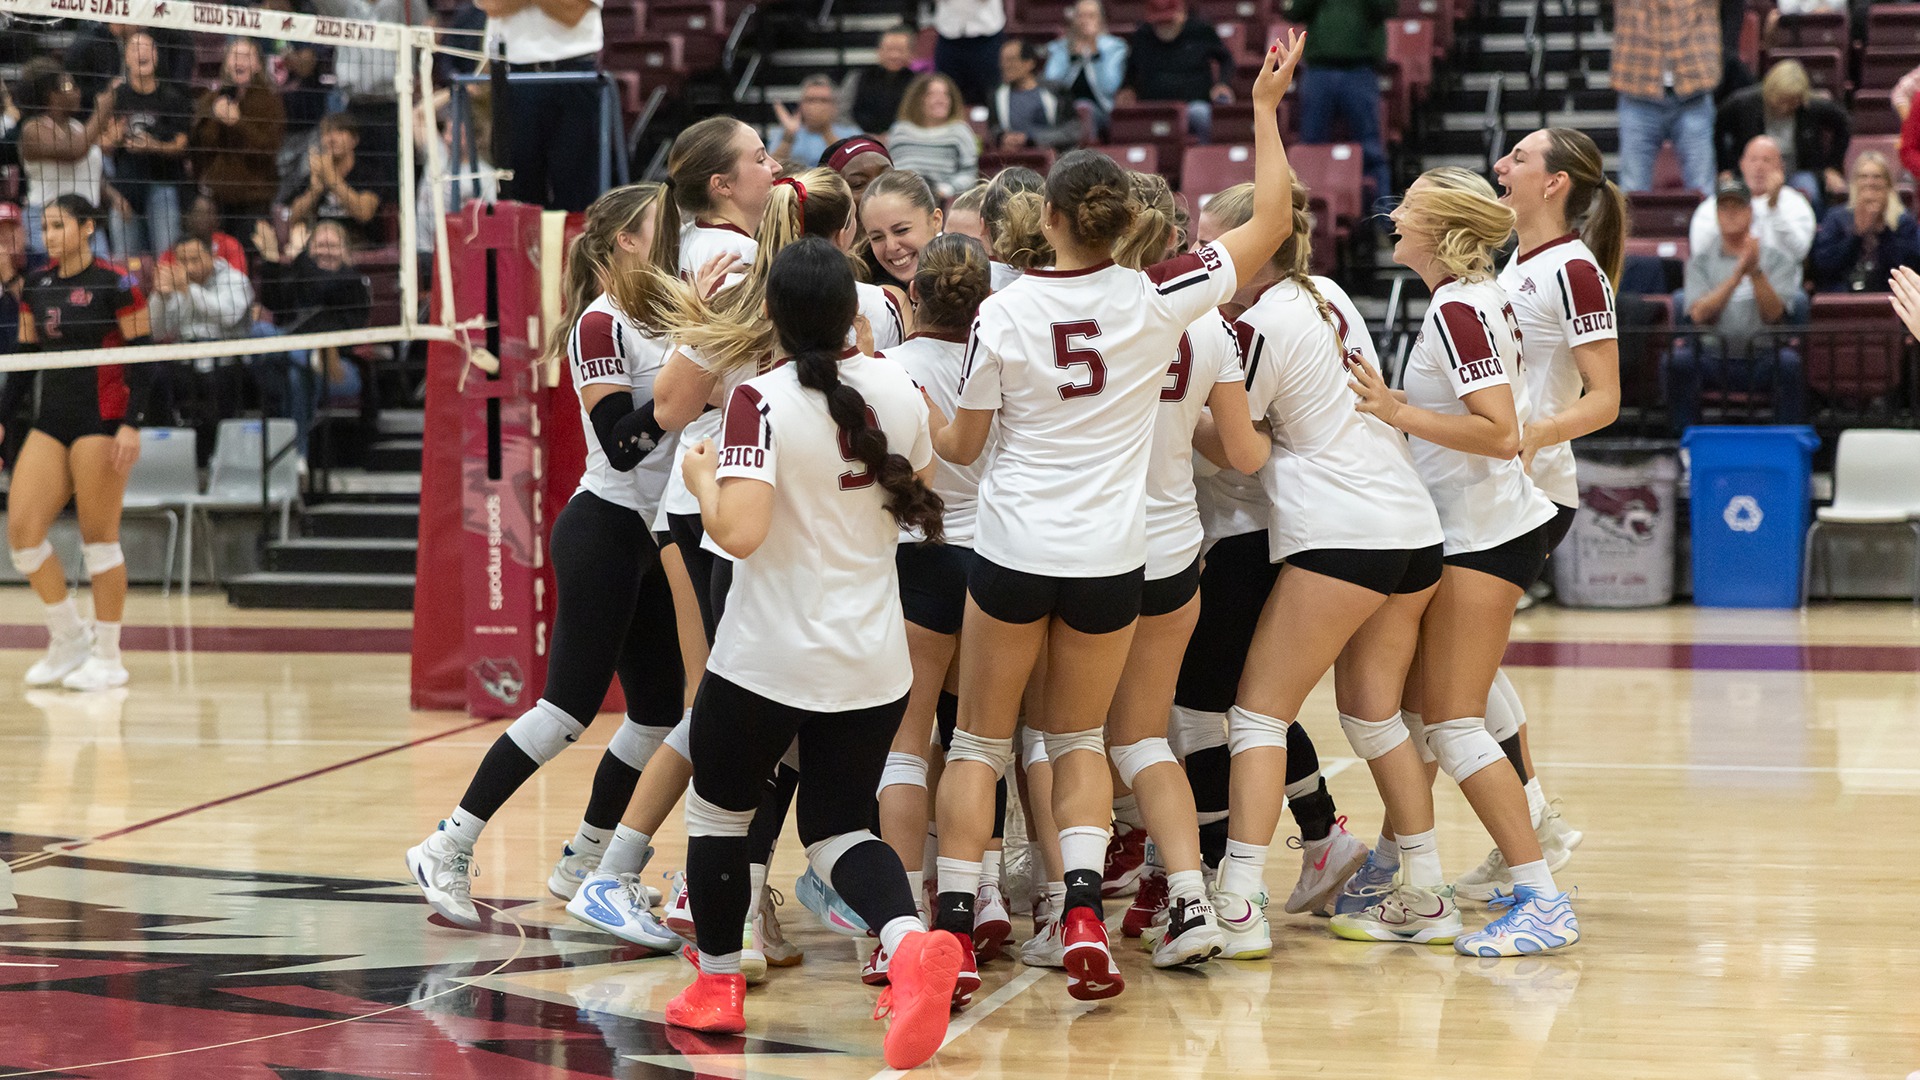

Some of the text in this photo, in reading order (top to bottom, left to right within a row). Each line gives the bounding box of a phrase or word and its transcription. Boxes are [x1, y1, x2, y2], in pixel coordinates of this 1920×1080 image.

[1573, 312, 1613, 335] CHICO
[580, 359, 625, 382] CHICO
[1050, 319, 1108, 401] 5
[1458, 357, 1503, 384] CHICO
[716, 447, 764, 469] CHICO
[836, 404, 882, 491] 9
[1190, 905, 1212, 915] TIME
